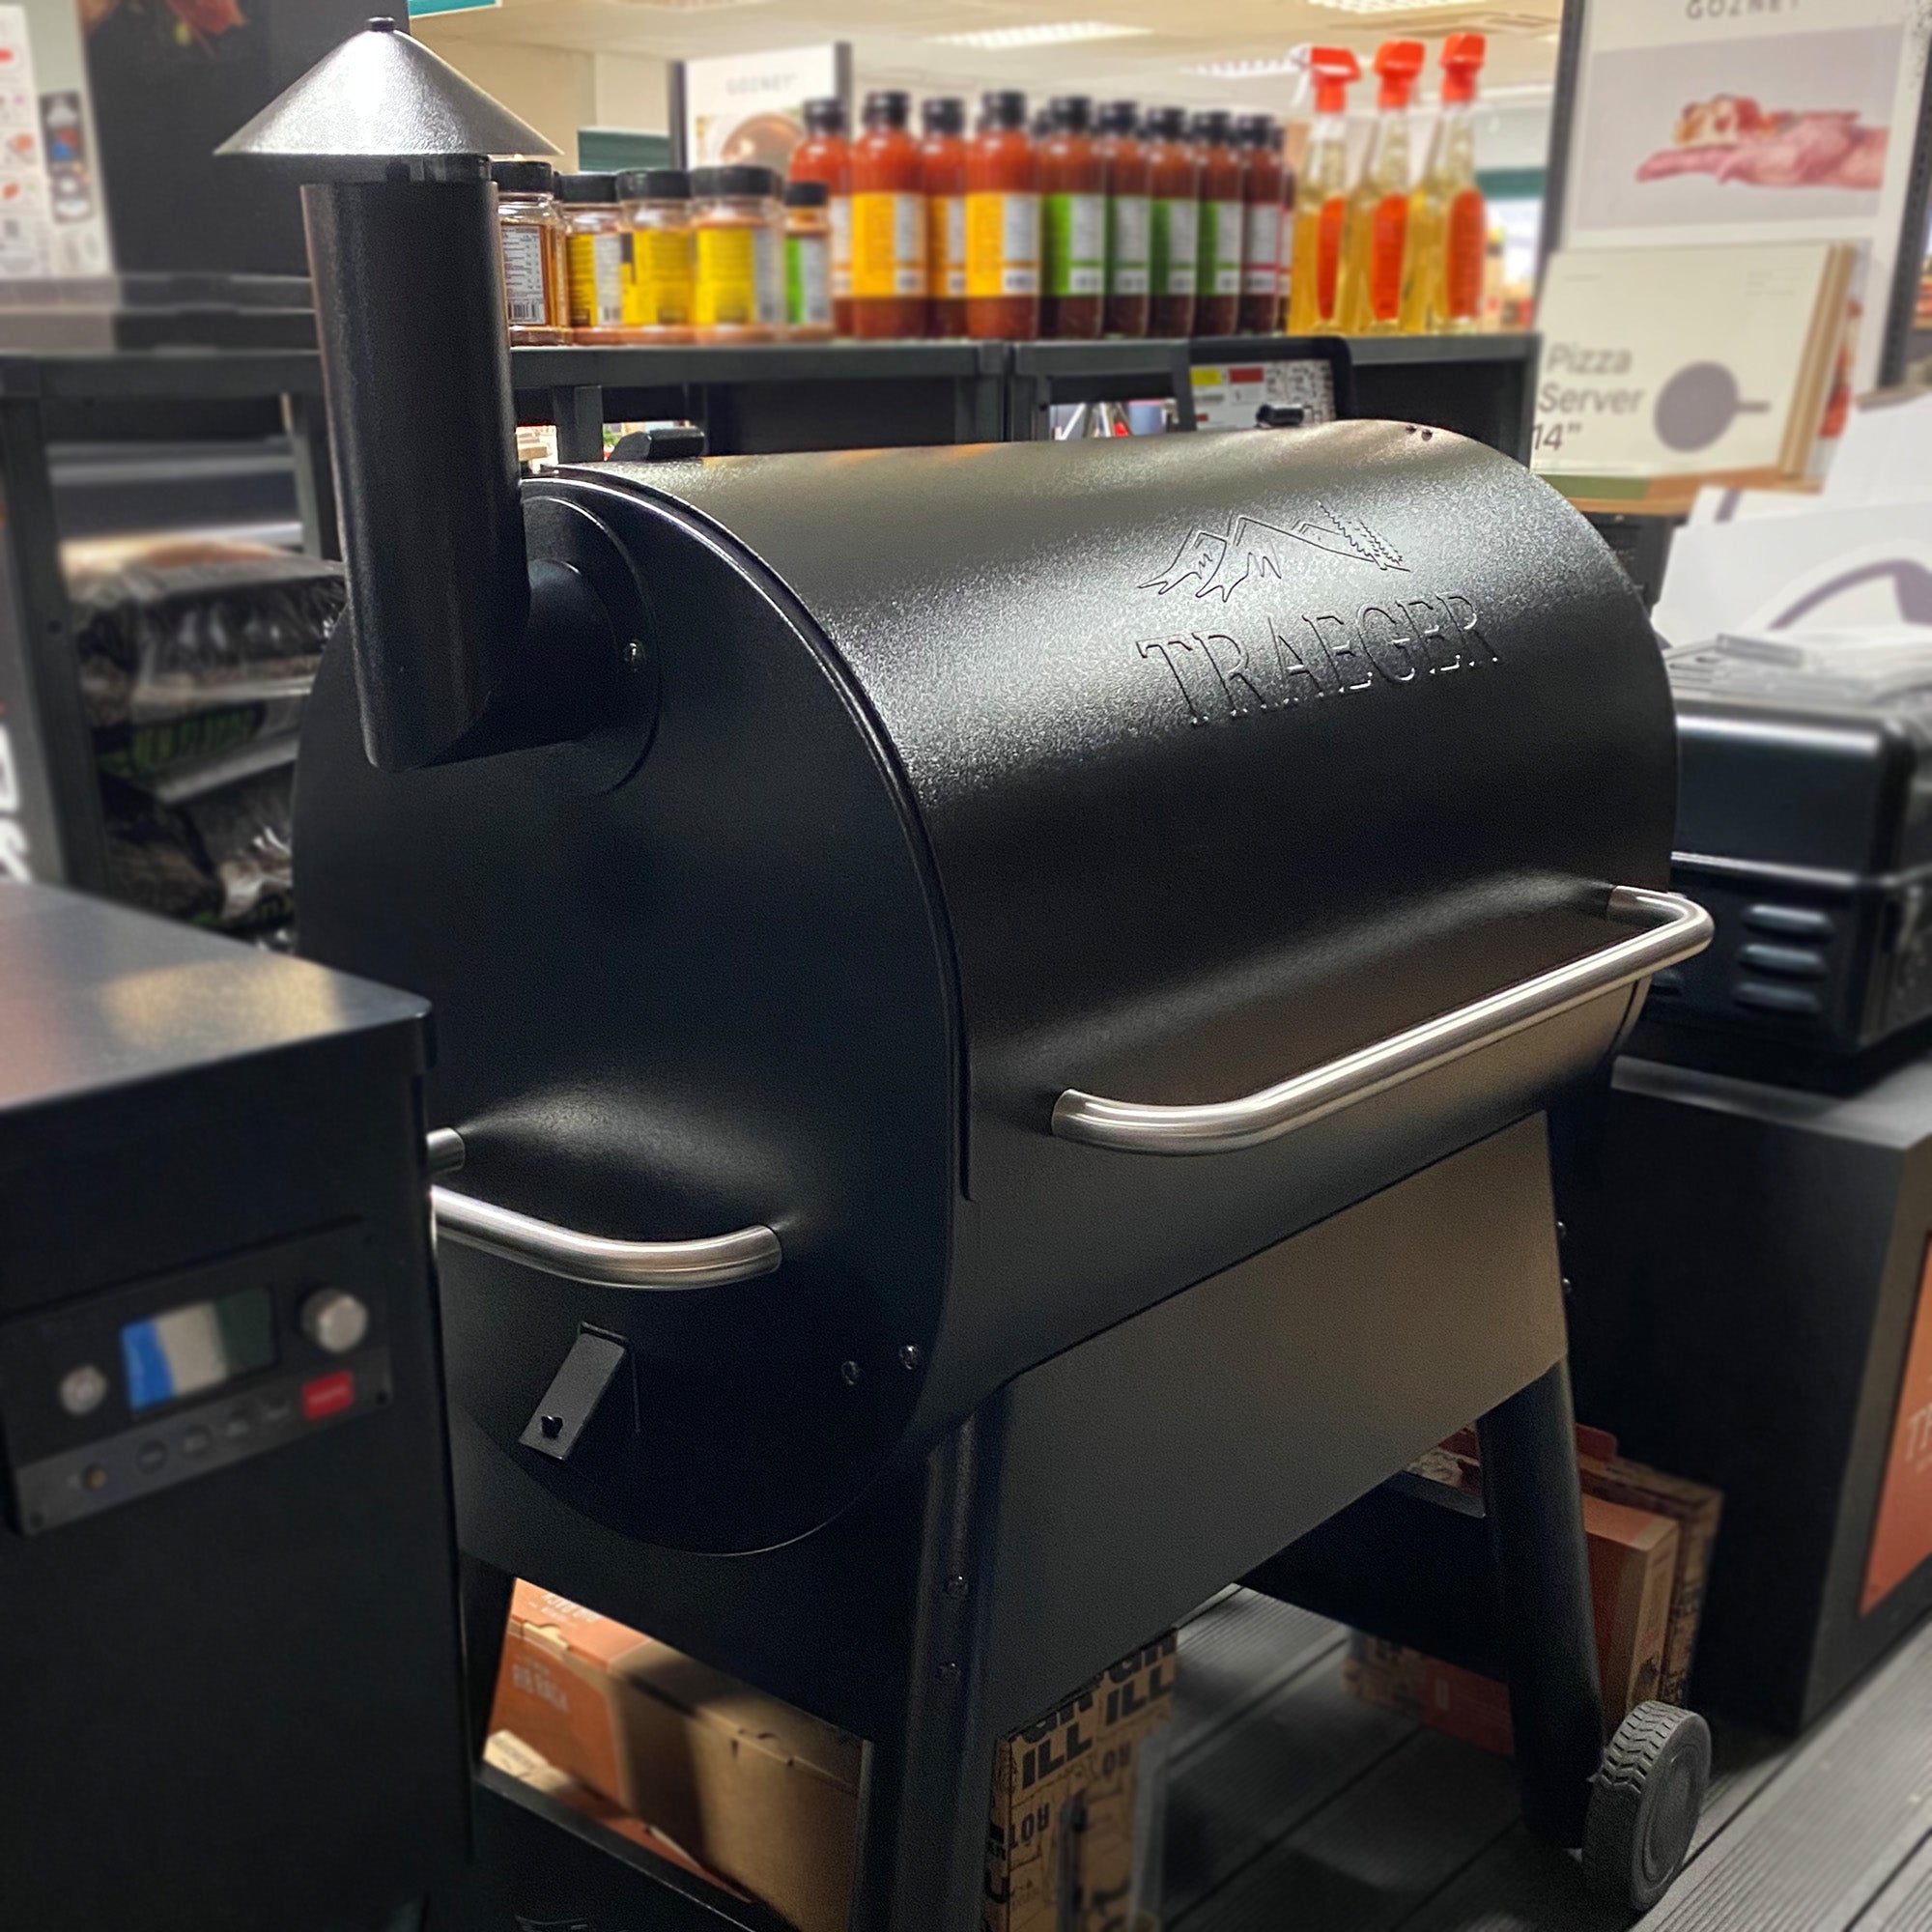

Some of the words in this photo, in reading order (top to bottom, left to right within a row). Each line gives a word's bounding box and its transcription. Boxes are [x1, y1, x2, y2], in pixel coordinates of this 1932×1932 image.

[1548, 343, 1632, 375] Pizza
[1538, 383, 1645, 414] Server
[1136, 591, 1500, 724] TRAEGER
